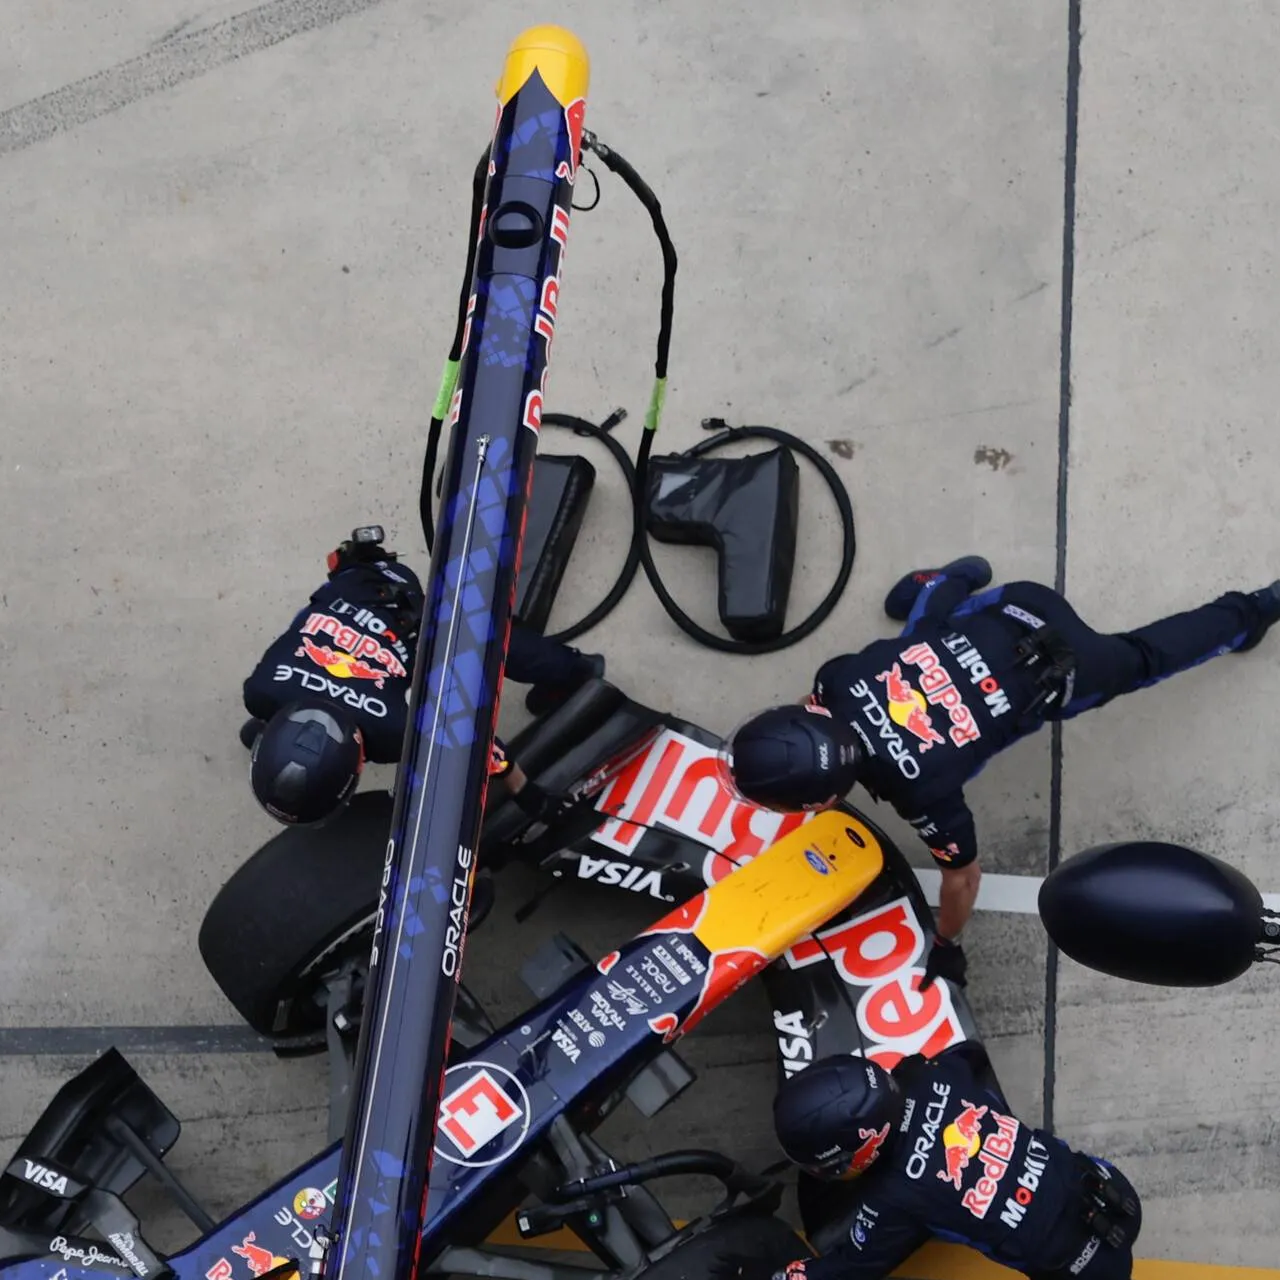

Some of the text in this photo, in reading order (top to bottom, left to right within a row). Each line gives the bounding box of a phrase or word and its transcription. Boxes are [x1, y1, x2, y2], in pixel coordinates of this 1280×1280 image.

[300, 612, 363, 652] Bull
[273, 664, 388, 718] ORACLE
[899, 641, 981, 748] Red Bull
[956, 648, 1011, 718] Mobil
[849, 679, 920, 779] ORACLE
[578, 855, 665, 900] VISA
[442, 845, 471, 976] ORACLE
[675, 942, 707, 975] Mobil
[626, 965, 662, 1004] CARLYLE
[567, 1009, 595, 1033] AT&T
[590, 990, 626, 1031] TRADE
[590, 1004, 613, 1027] AVA
[552, 1028, 582, 1064] VISA
[774, 1011, 812, 1079] ISA
[905, 1082, 951, 1179] ORACLE
[24, 1160, 68, 1194] VISA
[961, 1151, 1008, 1219] Red
[1000, 1158, 1046, 1229] Mobil
[49, 1236, 84, 1260] Pepe
